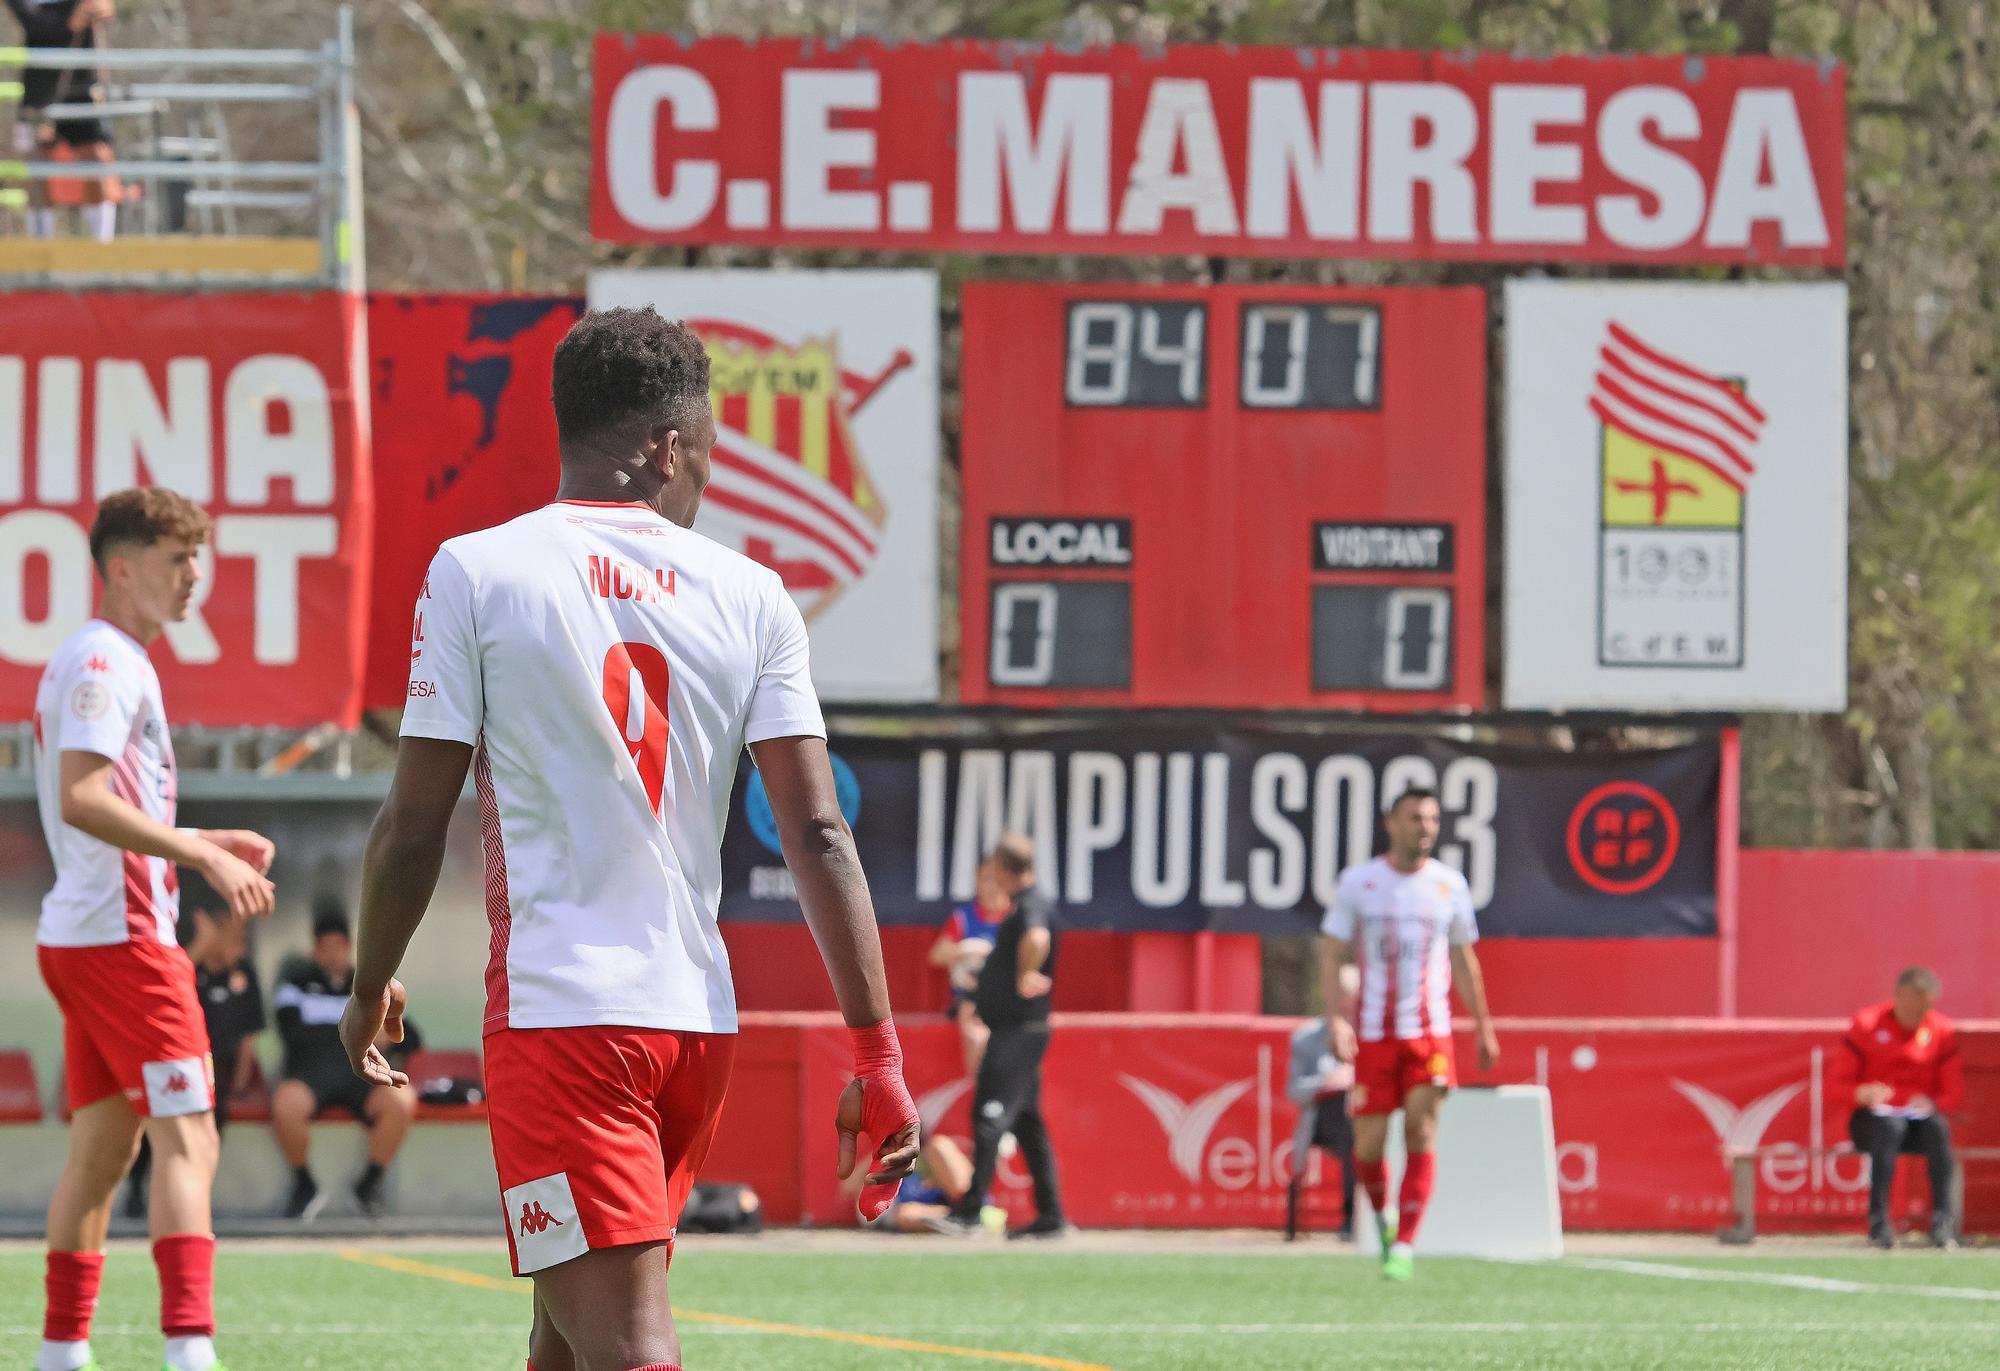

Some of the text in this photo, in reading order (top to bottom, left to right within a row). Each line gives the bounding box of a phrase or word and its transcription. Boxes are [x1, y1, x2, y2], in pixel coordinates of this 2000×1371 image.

[1066, 302, 1379, 408] 84 07
[0, 352, 337, 507] INA
[588, 554, 676, 609] NOAH
[992, 522, 1131, 564] LOCAL
[1319, 526, 1444, 567] VISITANT
[991, 583, 1057, 686] 0
[1383, 588, 1451, 690] 0
[407, 680, 437, 698] ESA
[602, 641, 670, 815] 9
